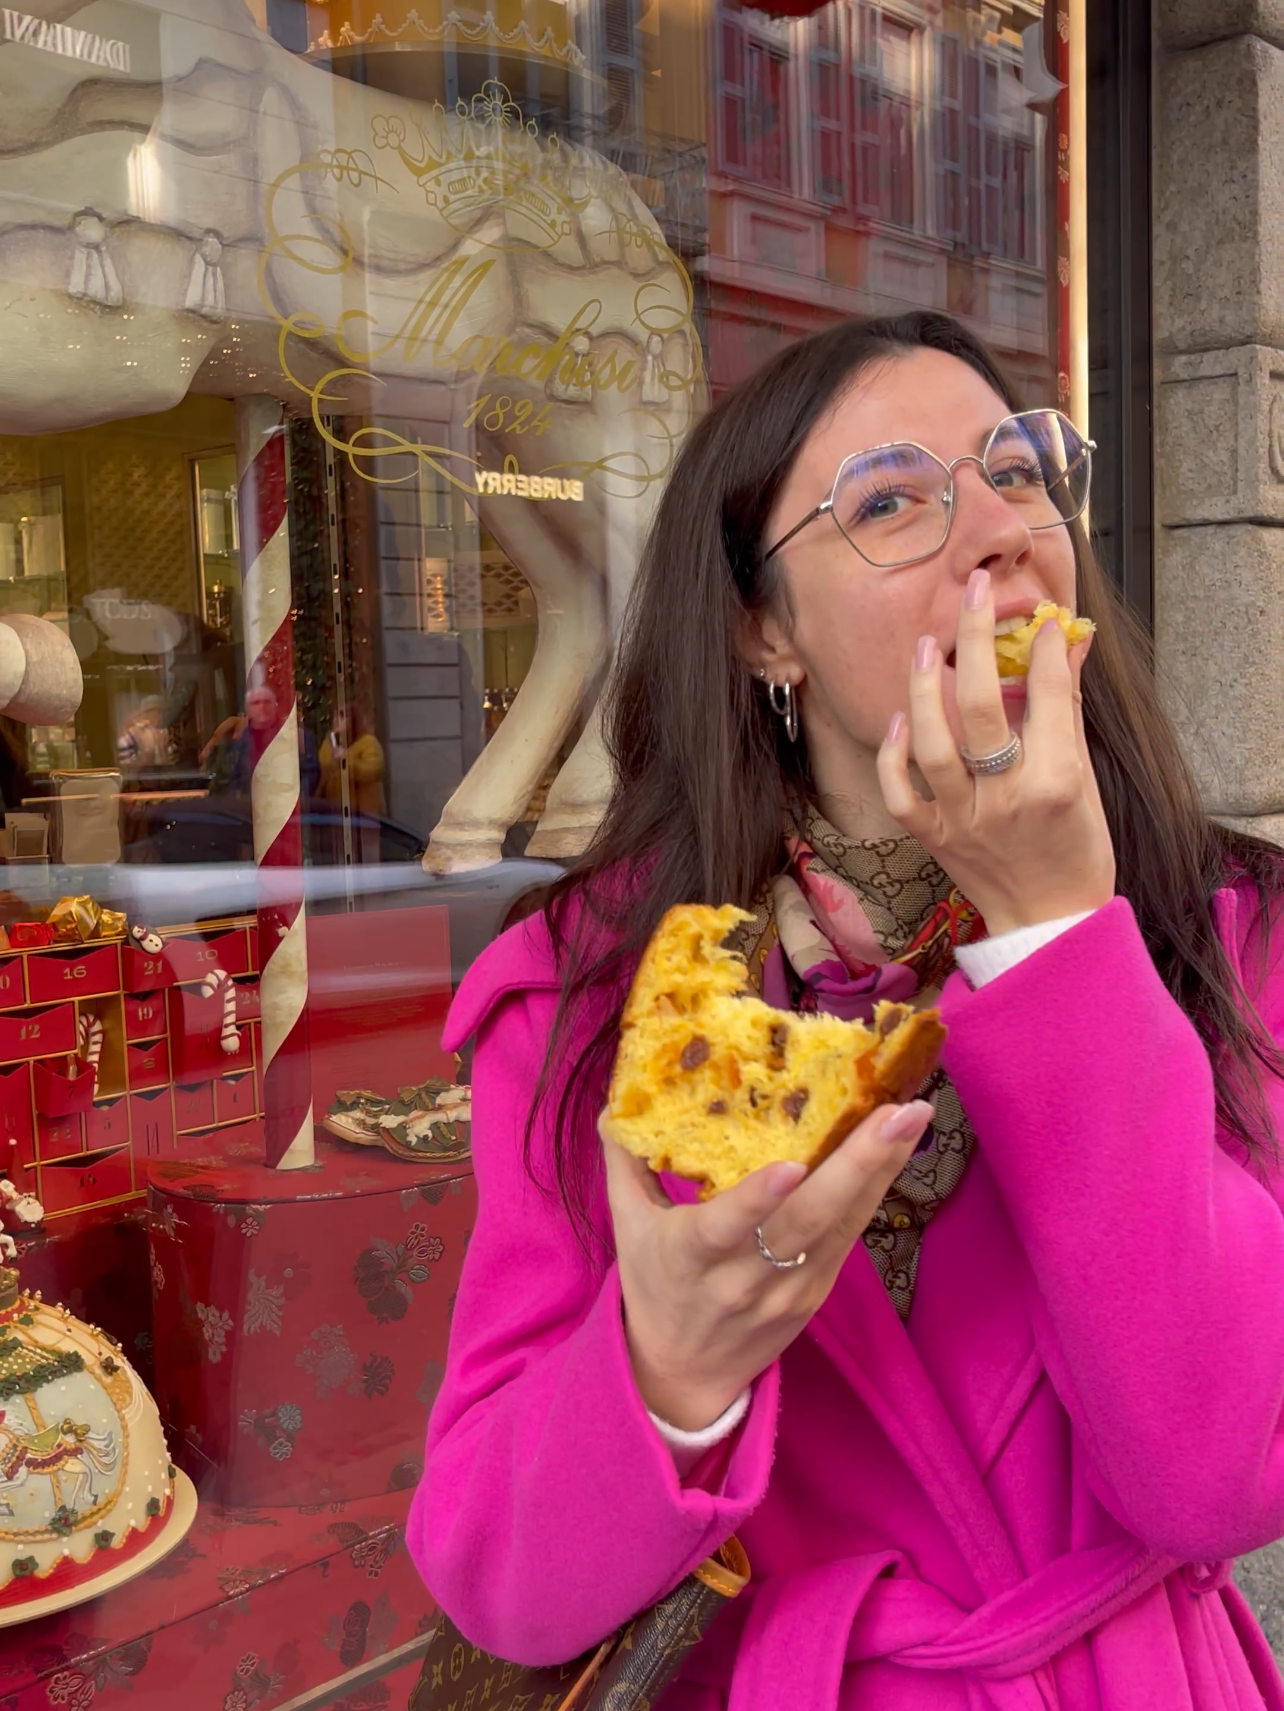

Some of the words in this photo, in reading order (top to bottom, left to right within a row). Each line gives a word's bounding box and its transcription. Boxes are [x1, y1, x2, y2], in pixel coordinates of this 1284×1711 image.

[335, 254, 642, 393] Marchesi
[463, 394, 552, 436] 1824
[63, 966, 87, 980] 16
[144, 960, 163, 975] 21
[20, 1024, 40, 1041] 12
